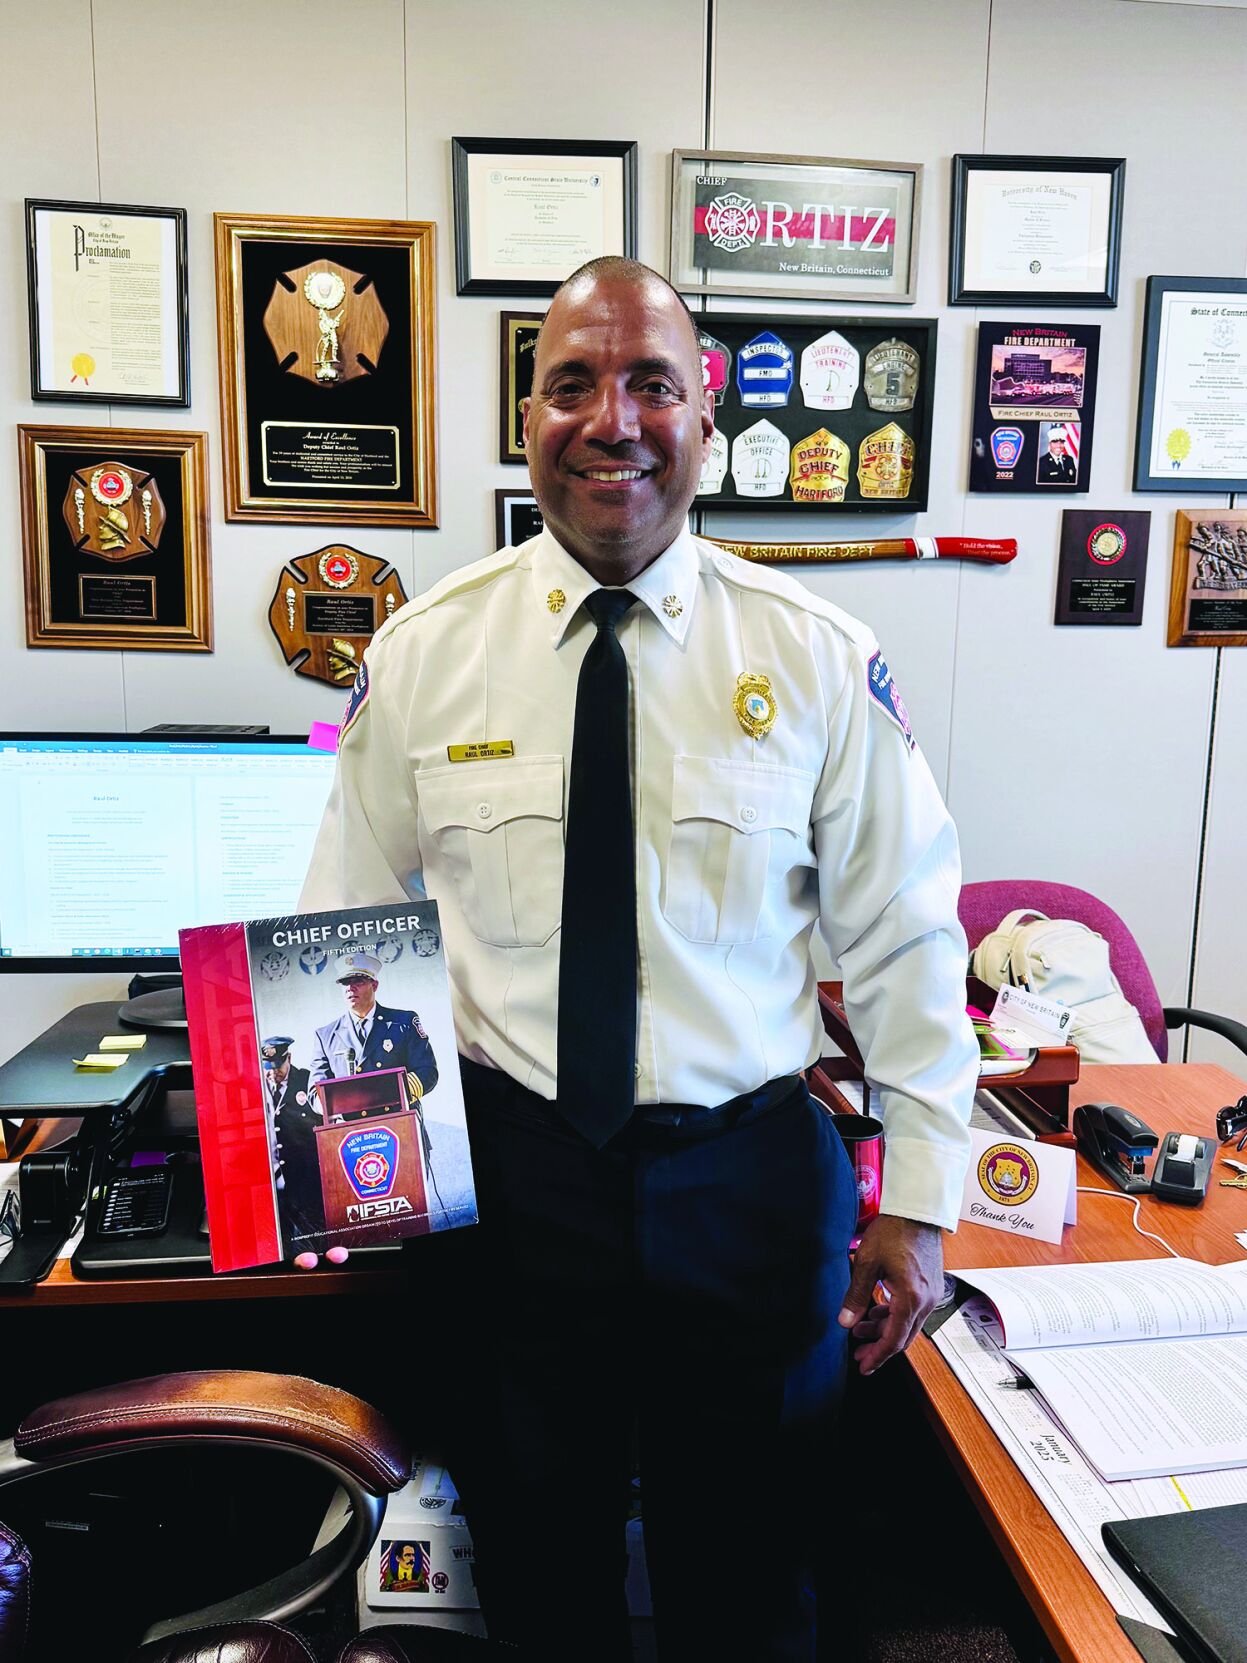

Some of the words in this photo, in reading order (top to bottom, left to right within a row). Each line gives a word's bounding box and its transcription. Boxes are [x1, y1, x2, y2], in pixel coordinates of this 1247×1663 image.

[697, 176, 727, 185] CHIEF
[724, 197, 743, 206] FIRE
[779, 262, 799, 272] New
[801, 264, 836, 274] Britain,
[836, 264, 889, 276] Connecticut
[1191, 307, 1210, 316] State
[1212, 308, 1219, 316] of
[1034, 328, 1068, 337] BRITAIN
[1004, 336, 1022, 345] FIRE
[1024, 337, 1076, 347] DEPARTMENT
[886, 373, 900, 395] 5
[799, 447, 843, 461] DEPUTY
[799, 461, 840, 474] CHIEF
[794, 485, 843, 498] HARTFORD
[750, 545, 802, 558] BRITAIN
[806, 545, 836, 558] FIRE
[840, 545, 875, 557] DEPT
[272, 926, 332, 947] CHIEF
[337, 915, 421, 939] OFFICER
[322, 947, 345, 957] FIFTH
[346, 943, 377, 954] EDITION
[1009, 994, 1020, 1002] CITY
[346, 1136, 362, 1149] NEW
[364, 1133, 391, 1142] BRITAIN
[360, 1196, 413, 1218] IFSTA
[970, 1202, 1007, 1223] Thank
[1008, 1213, 1035, 1229] You
[1030, 1440, 1055, 1461] 2025
[1040, 1435, 1072, 1466] January
